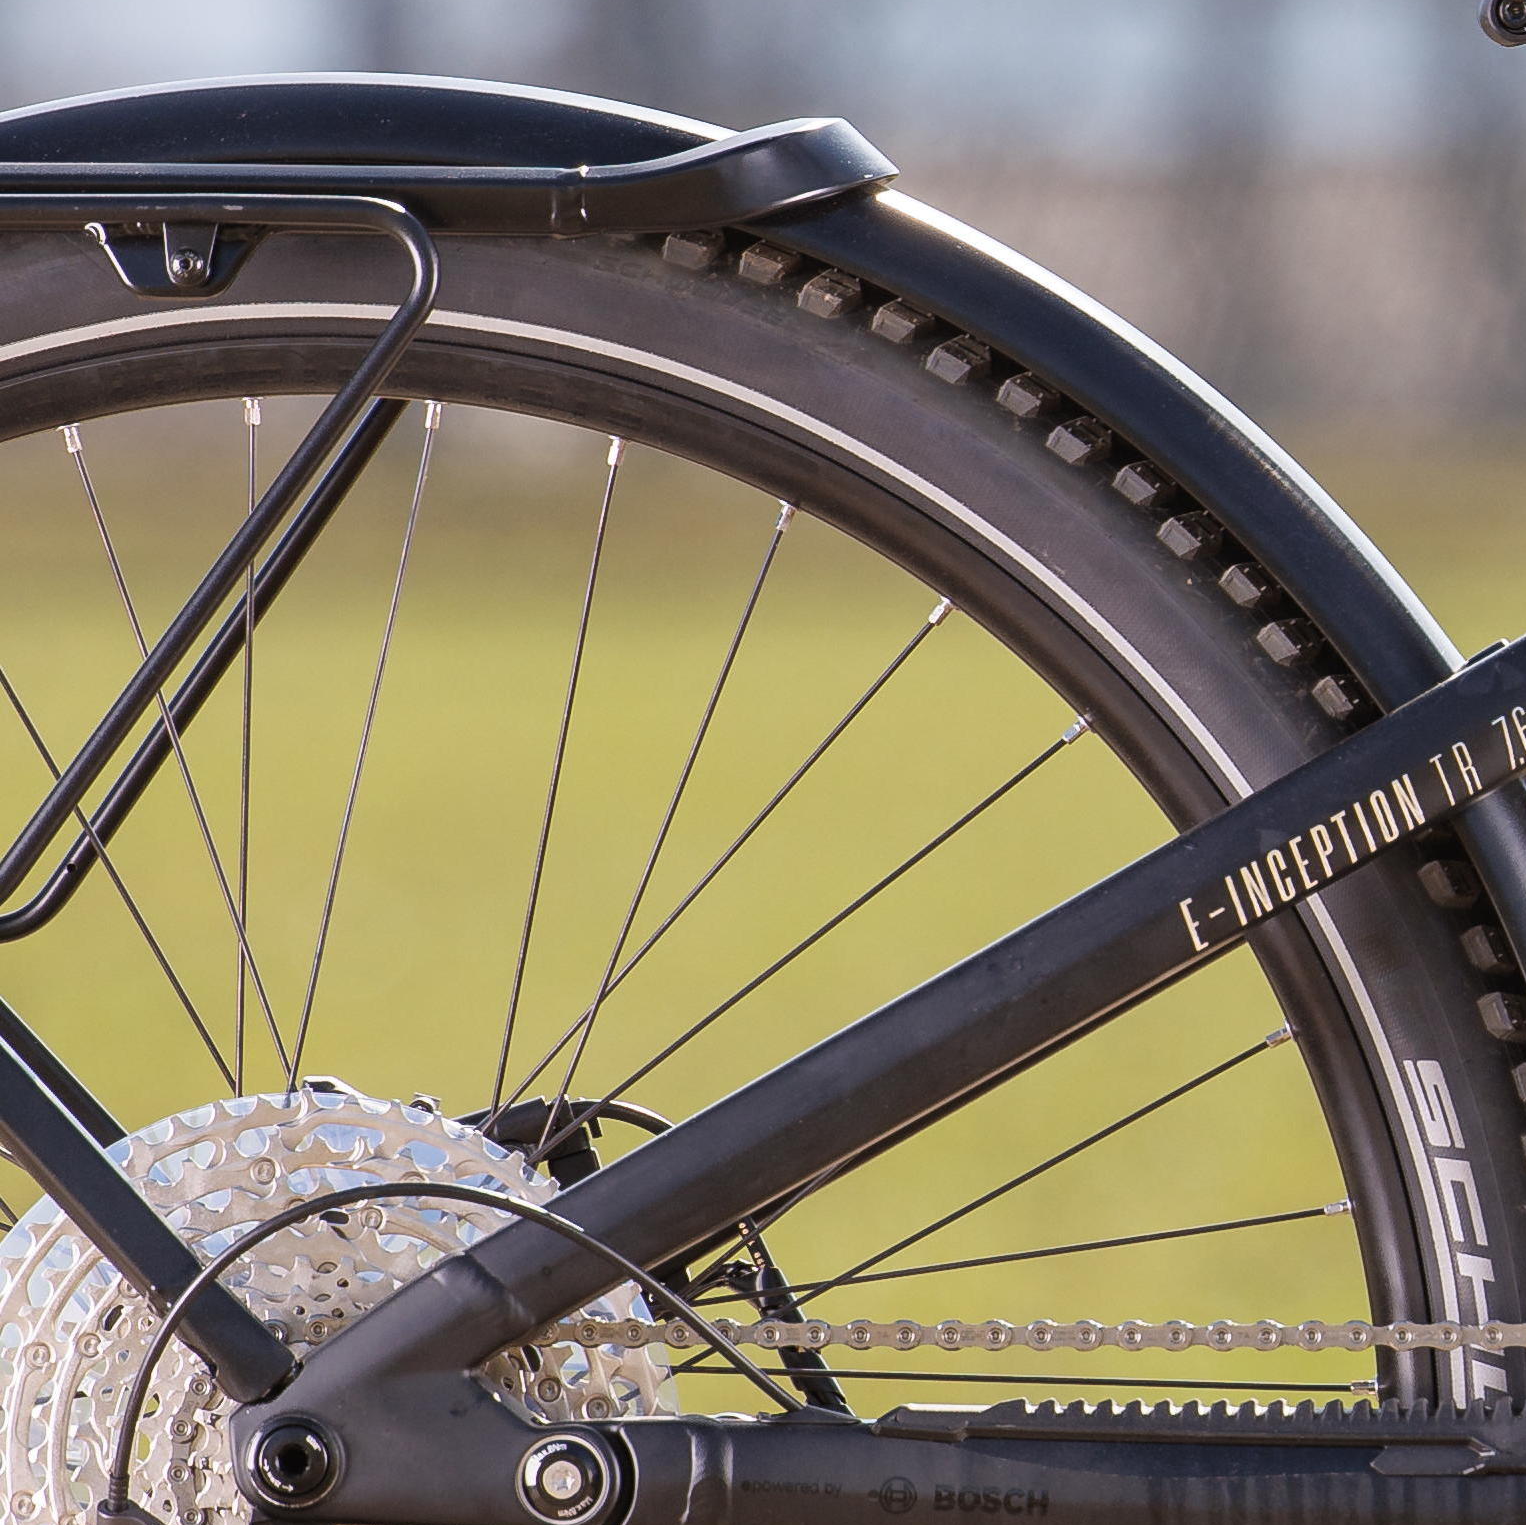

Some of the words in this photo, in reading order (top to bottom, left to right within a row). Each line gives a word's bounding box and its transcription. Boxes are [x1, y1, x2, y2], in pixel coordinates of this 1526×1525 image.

[1179, 773, 1426, 952] E-INCEPTION
[1429, 741, 1483, 807] TR
[933, 1483, 1050, 1517] BOSCH
